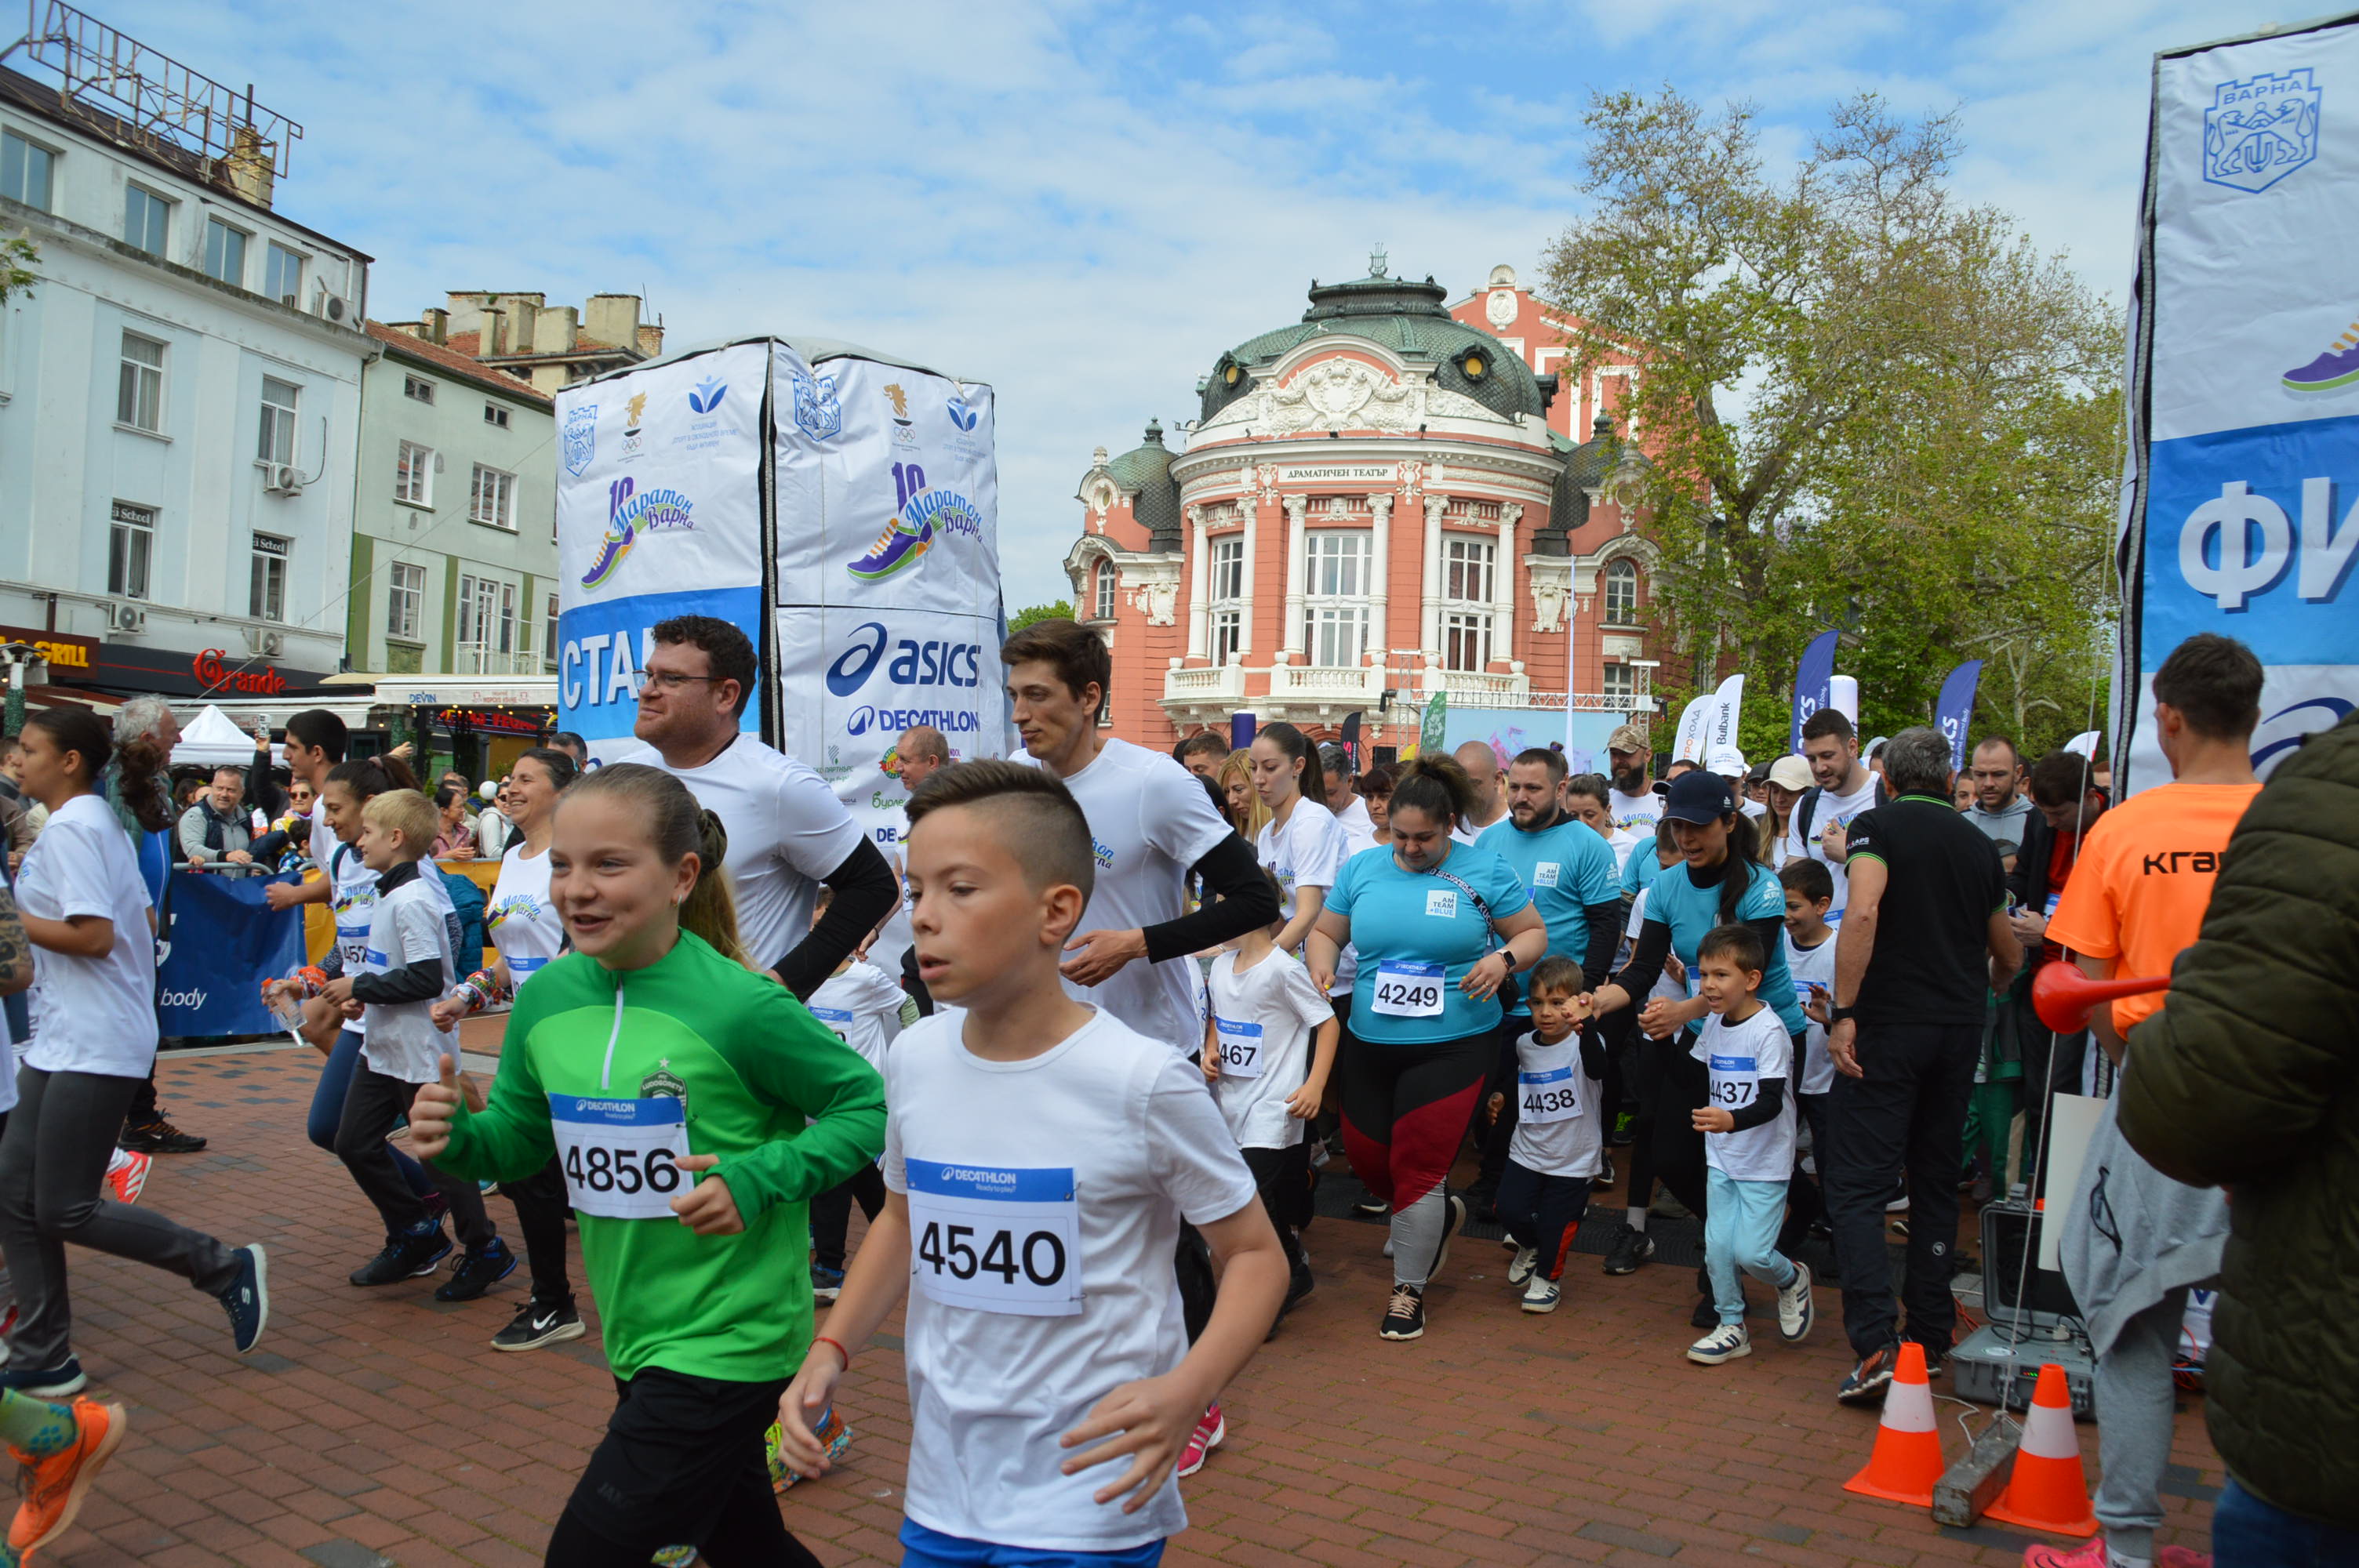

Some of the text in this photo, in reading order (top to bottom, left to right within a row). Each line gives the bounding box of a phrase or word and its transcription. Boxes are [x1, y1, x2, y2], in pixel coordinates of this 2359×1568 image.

[2223, 80, 2303, 105] ВАРНА
[1287, 469, 1388, 479] ДРАМАТИЧЕН ТЕАТЪР
[121, 508, 151, 524] School
[614, 488, 693, 540] Маратон
[645, 506, 694, 531] Варна
[906, 490, 982, 533] Маратон
[260, 539, 285, 553] School
[34, 641, 89, 668] GRILL
[193, 648, 288, 695] Grande
[409, 691, 437, 703] DEVIN
[878, 710, 980, 731] DECATHLON
[1716, 702, 1731, 745] Bulbank
[877, 828, 898, 843] DE
[502, 895, 541, 916] Marathon
[160, 987, 207, 1011] body
[1378, 982, 1438, 1007] 4249
[1219, 1044, 1256, 1066] 467
[1524, 1089, 1576, 1113] 4438
[1710, 1080, 1753, 1104] 4437
[587, 1101, 635, 1112] DECATHLON
[566, 1145, 680, 1195] 4856
[955, 1169, 1016, 1184] DECATHLON
[919, 1221, 1066, 1287] 4540
